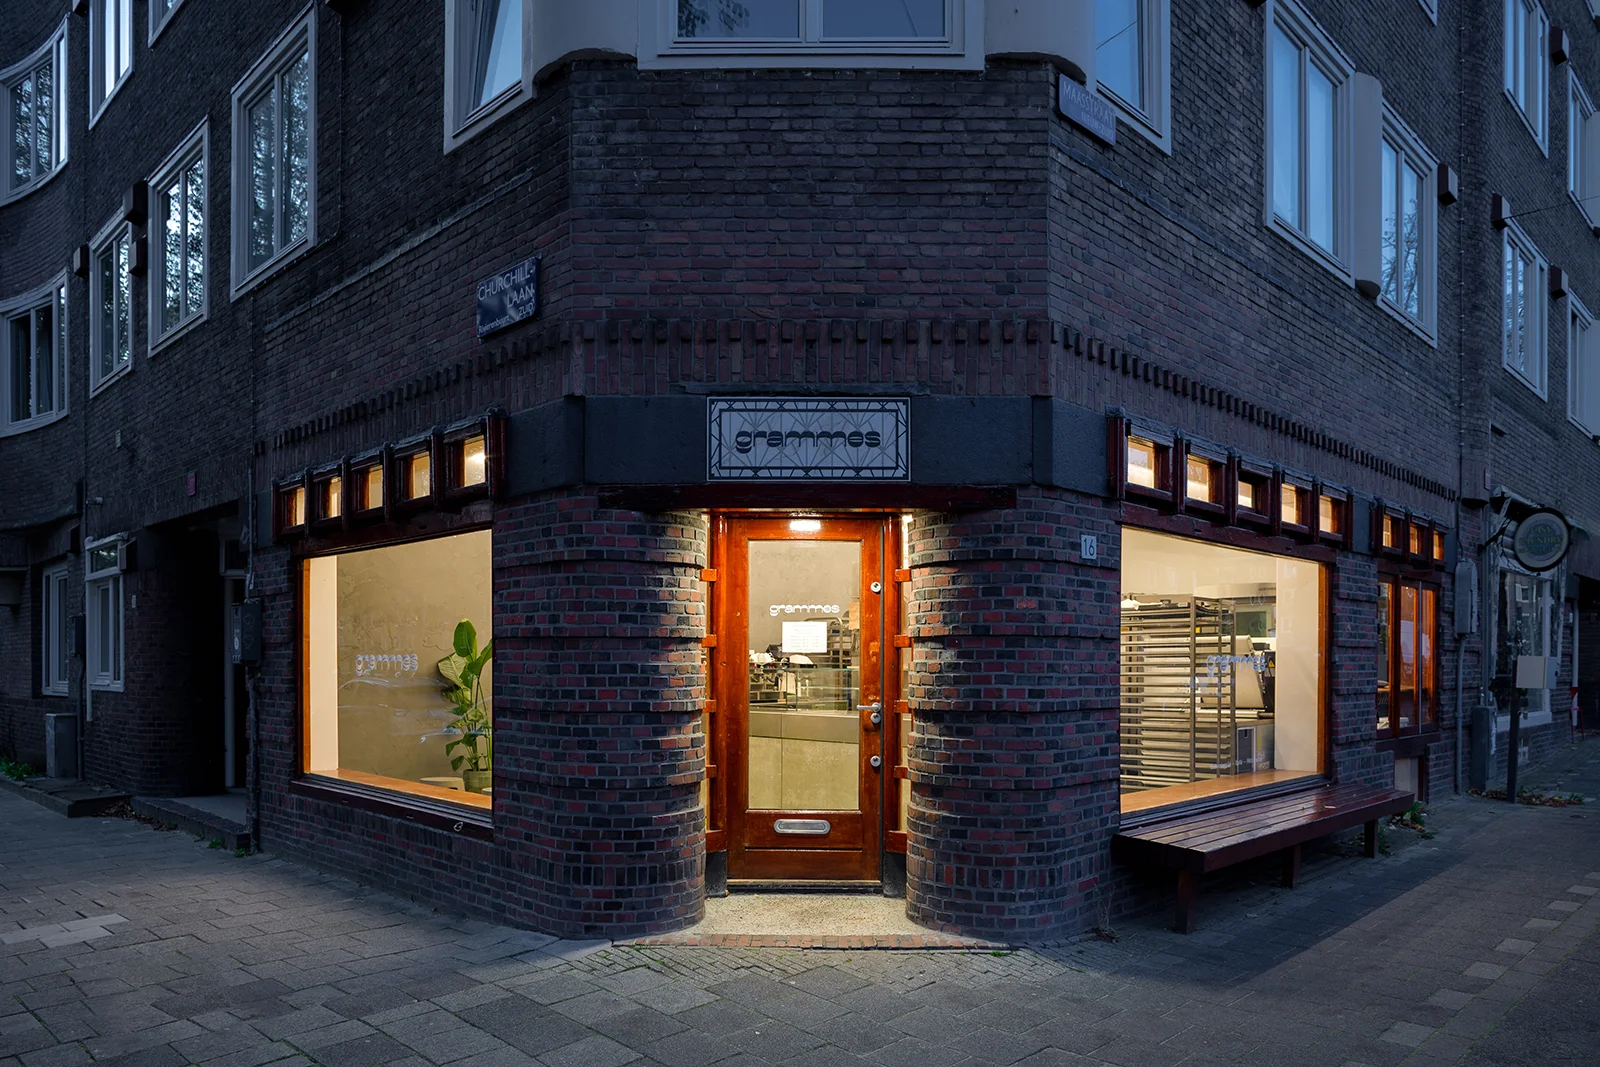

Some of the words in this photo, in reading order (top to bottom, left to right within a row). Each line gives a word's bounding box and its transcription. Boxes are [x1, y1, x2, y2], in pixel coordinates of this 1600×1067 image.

[1063, 81, 1114, 128] MAASSTRAAT
[507, 282, 534, 308] LAAN
[518, 302, 534, 316] ZUID
[735, 430, 881, 454] grammes
[1083, 538, 1095, 556] 16
[769, 604, 840, 617] grammes
[355, 653, 419, 677] grammes
[1206, 654, 1266, 678] grammes
